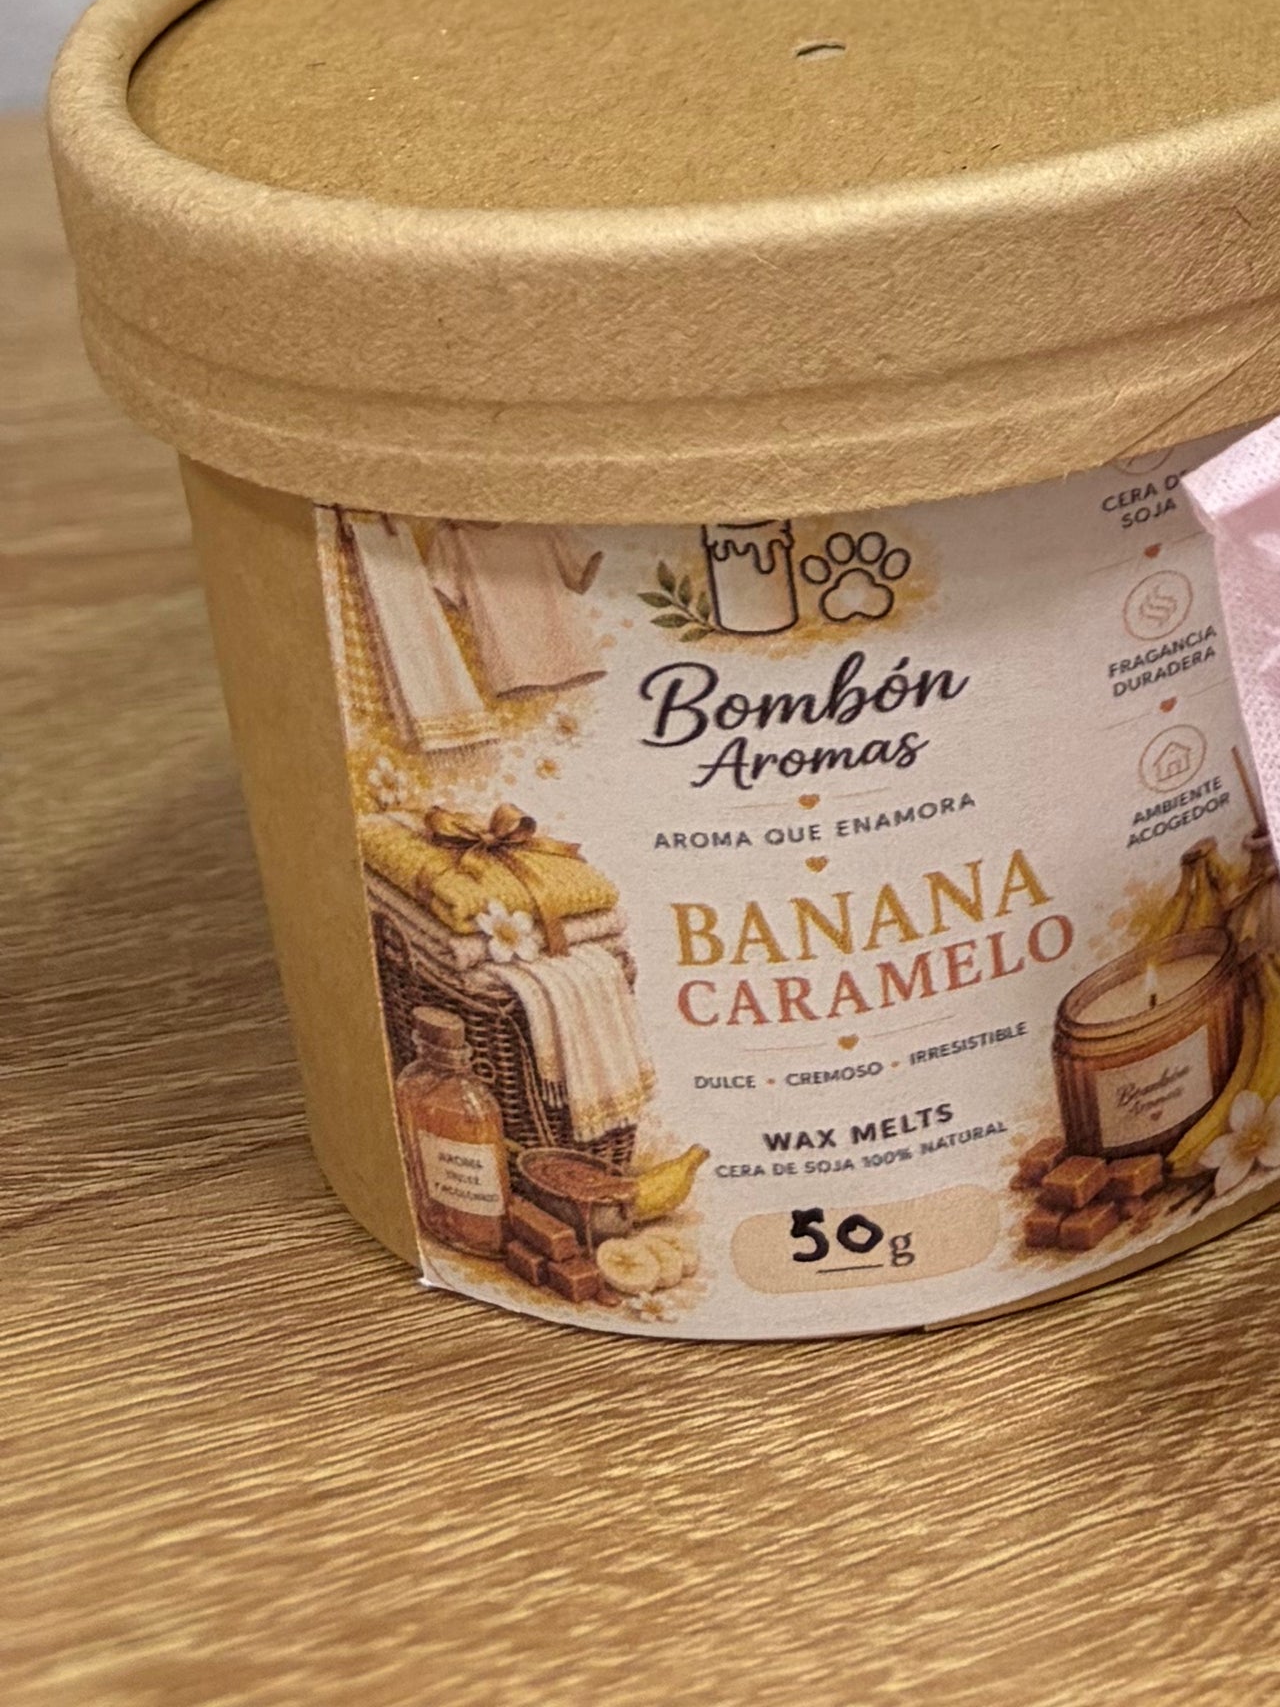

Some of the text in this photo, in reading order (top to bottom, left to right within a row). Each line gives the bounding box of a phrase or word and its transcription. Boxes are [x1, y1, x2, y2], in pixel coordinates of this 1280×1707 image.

[1102, 483, 1158, 512] CERA
[1121, 498, 1176, 528] SOJA
[1108, 625, 1217, 677] FRAGANCIA
[1113, 646, 1216, 697] DURADERA
[639, 650, 970, 748] Bombón
[690, 731, 931, 790] Aromas
[654, 792, 977, 850] AROMA QUE ENAMORA
[1126, 792, 1230, 848] ACOGEDOR
[1132, 776, 1222, 826] AMBIENTE
[670, 848, 1055, 967] BANANA
[677, 914, 1075, 1028] CARAMELO
[694, 1021, 1028, 1090] DULCE CREMOSO IRRESISTIBLE
[715, 1121, 1009, 1179] CERA DE SOJA 100% NATURAL
[763, 1102, 954, 1152] WAX MELTS
